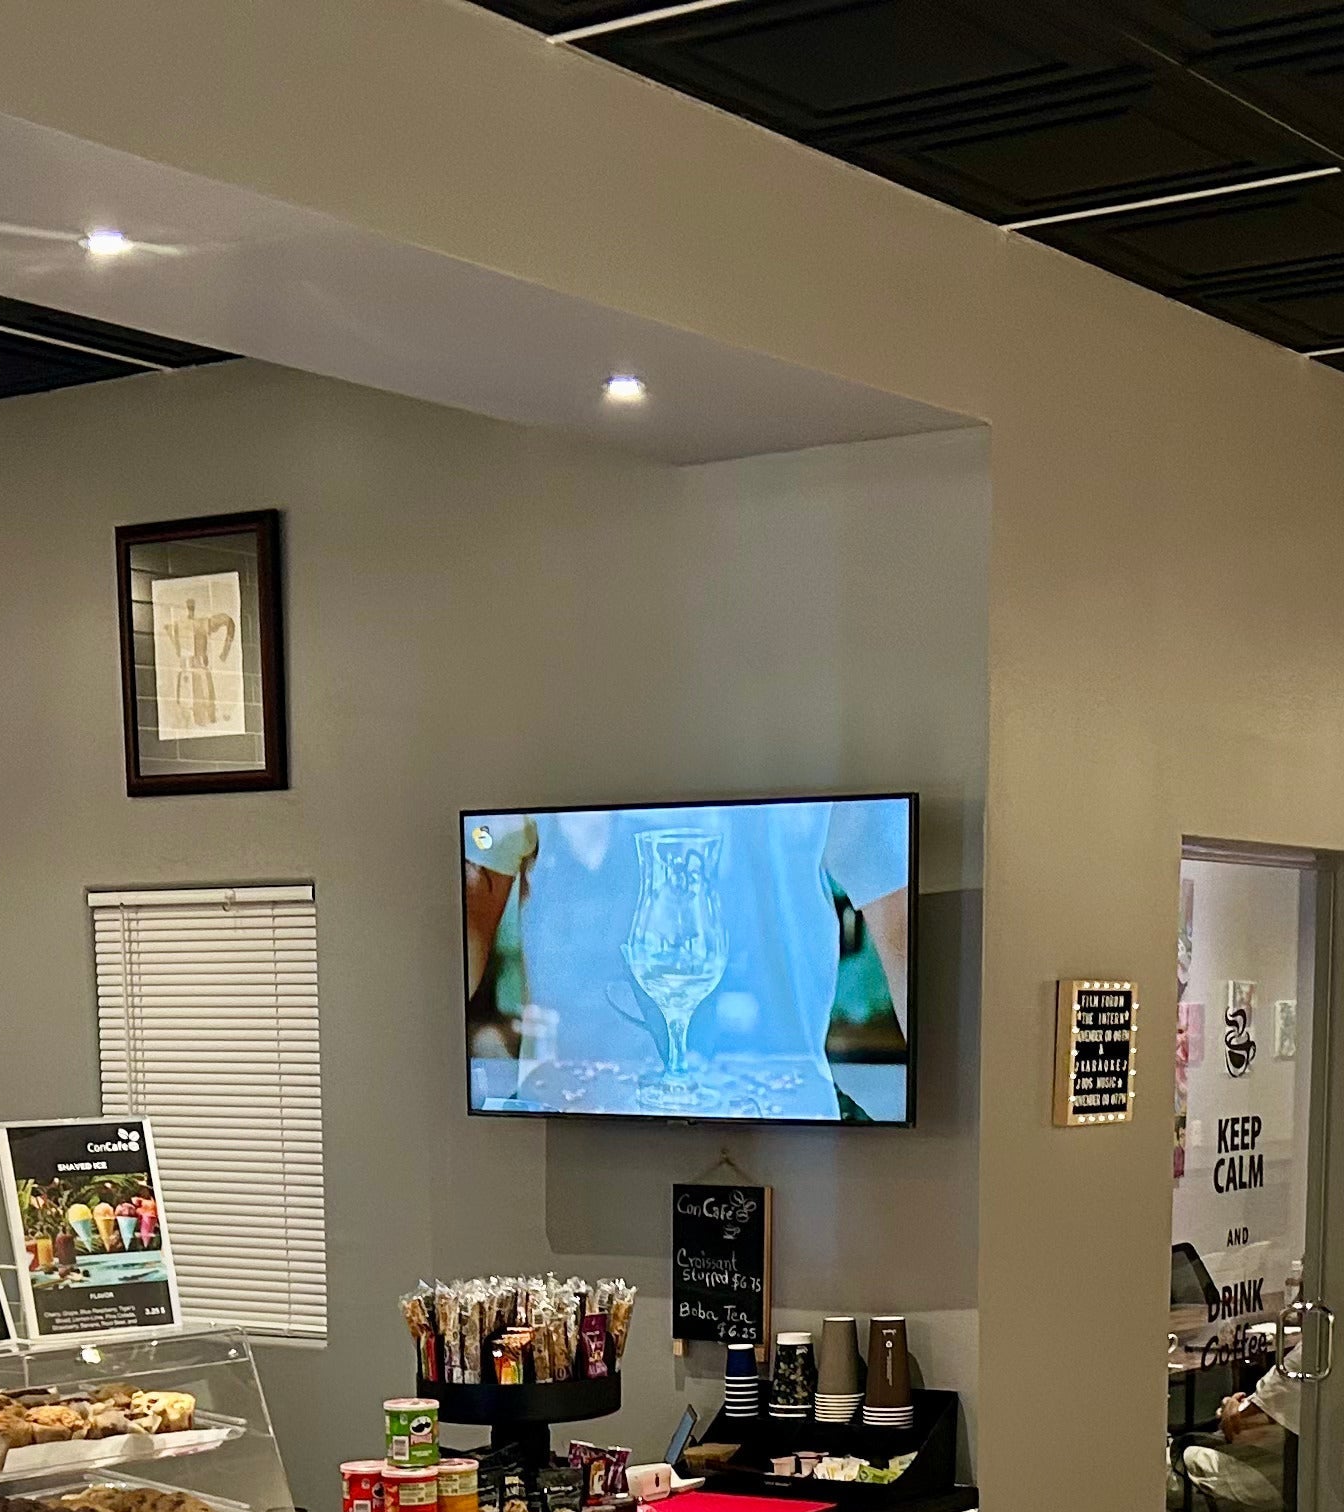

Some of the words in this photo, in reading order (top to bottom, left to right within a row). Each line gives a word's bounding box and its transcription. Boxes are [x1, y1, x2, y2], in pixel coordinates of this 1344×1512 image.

[1082, 995, 1099, 1008] FILM
[1217, 1115, 1262, 1154] KEEP
[57, 1162, 92, 1172] SHAVED
[1213, 1154, 1264, 1194] CALM
[1227, 1226, 1249, 1247] AND
[677, 1248, 738, 1271] Croissant
[1206, 1277, 1264, 1323] DRINK
[679, 1302, 719, 1320] Boba
[723, 1305, 756, 1324] Tea
[1201, 1322, 1267, 1371] Coffee
